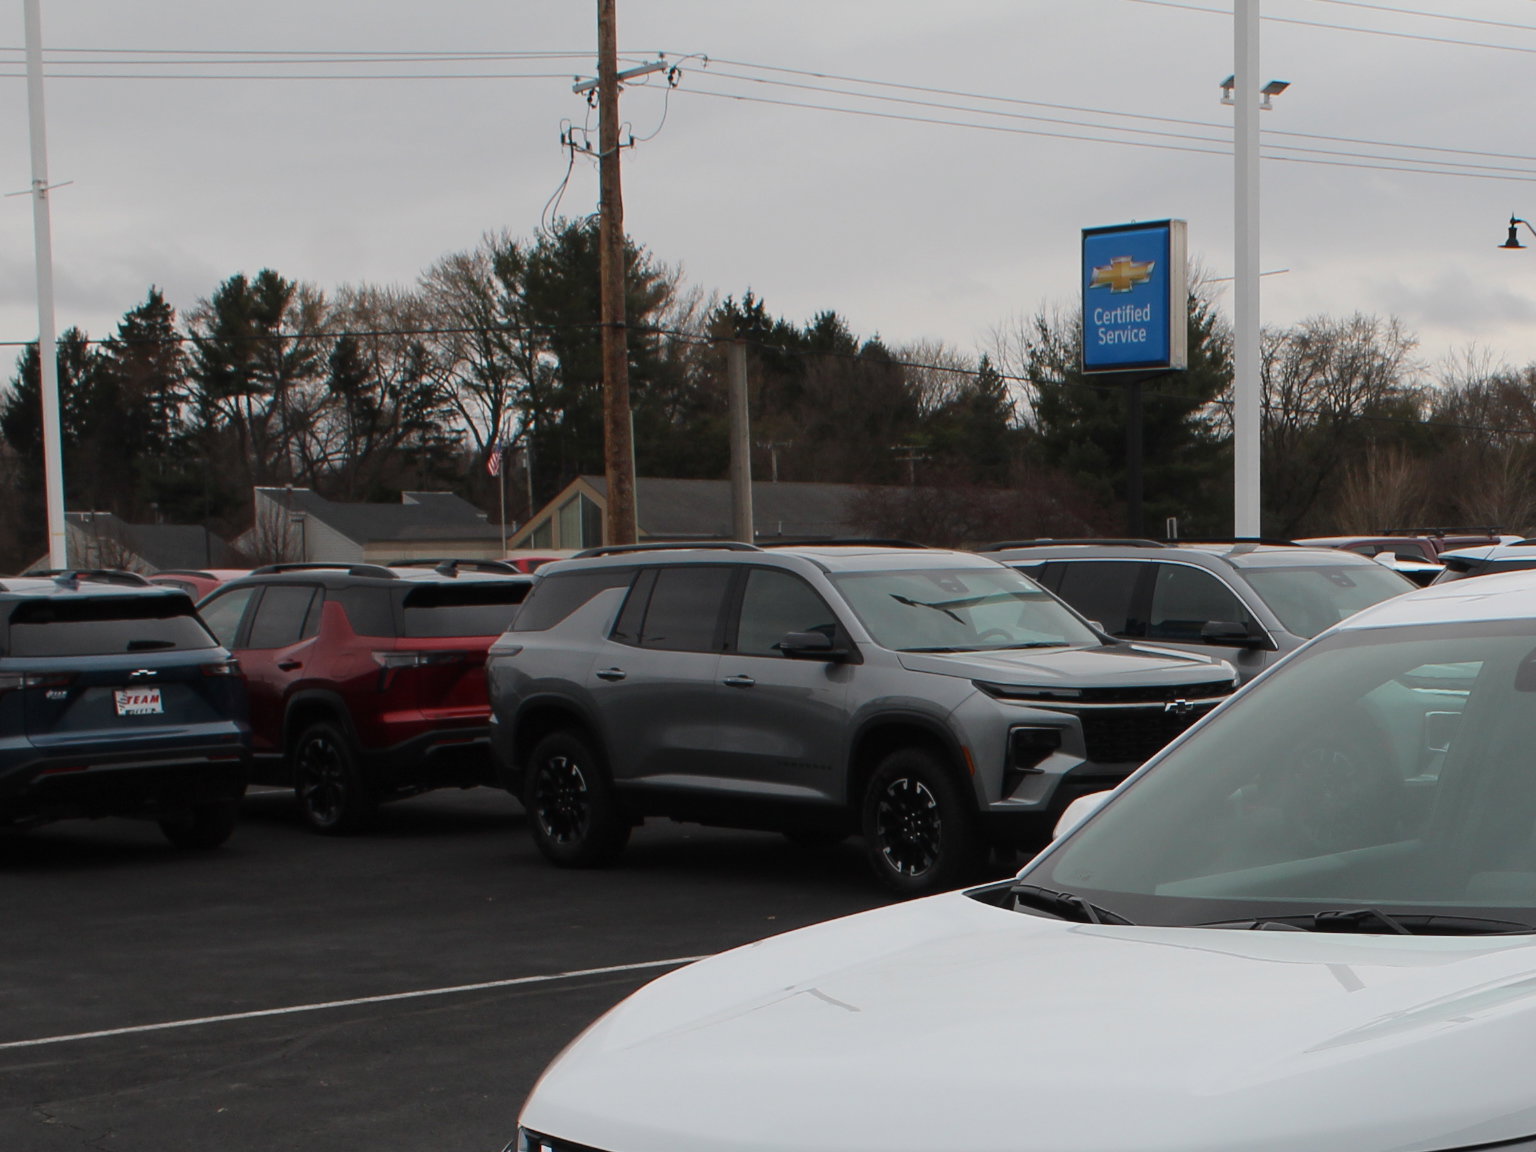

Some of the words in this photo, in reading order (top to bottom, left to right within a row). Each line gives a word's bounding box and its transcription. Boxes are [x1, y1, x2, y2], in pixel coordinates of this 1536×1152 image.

[1094, 303, 1151, 325] Certified
[1098, 325, 1147, 345] Service
[126, 694, 160, 705] TEAM
